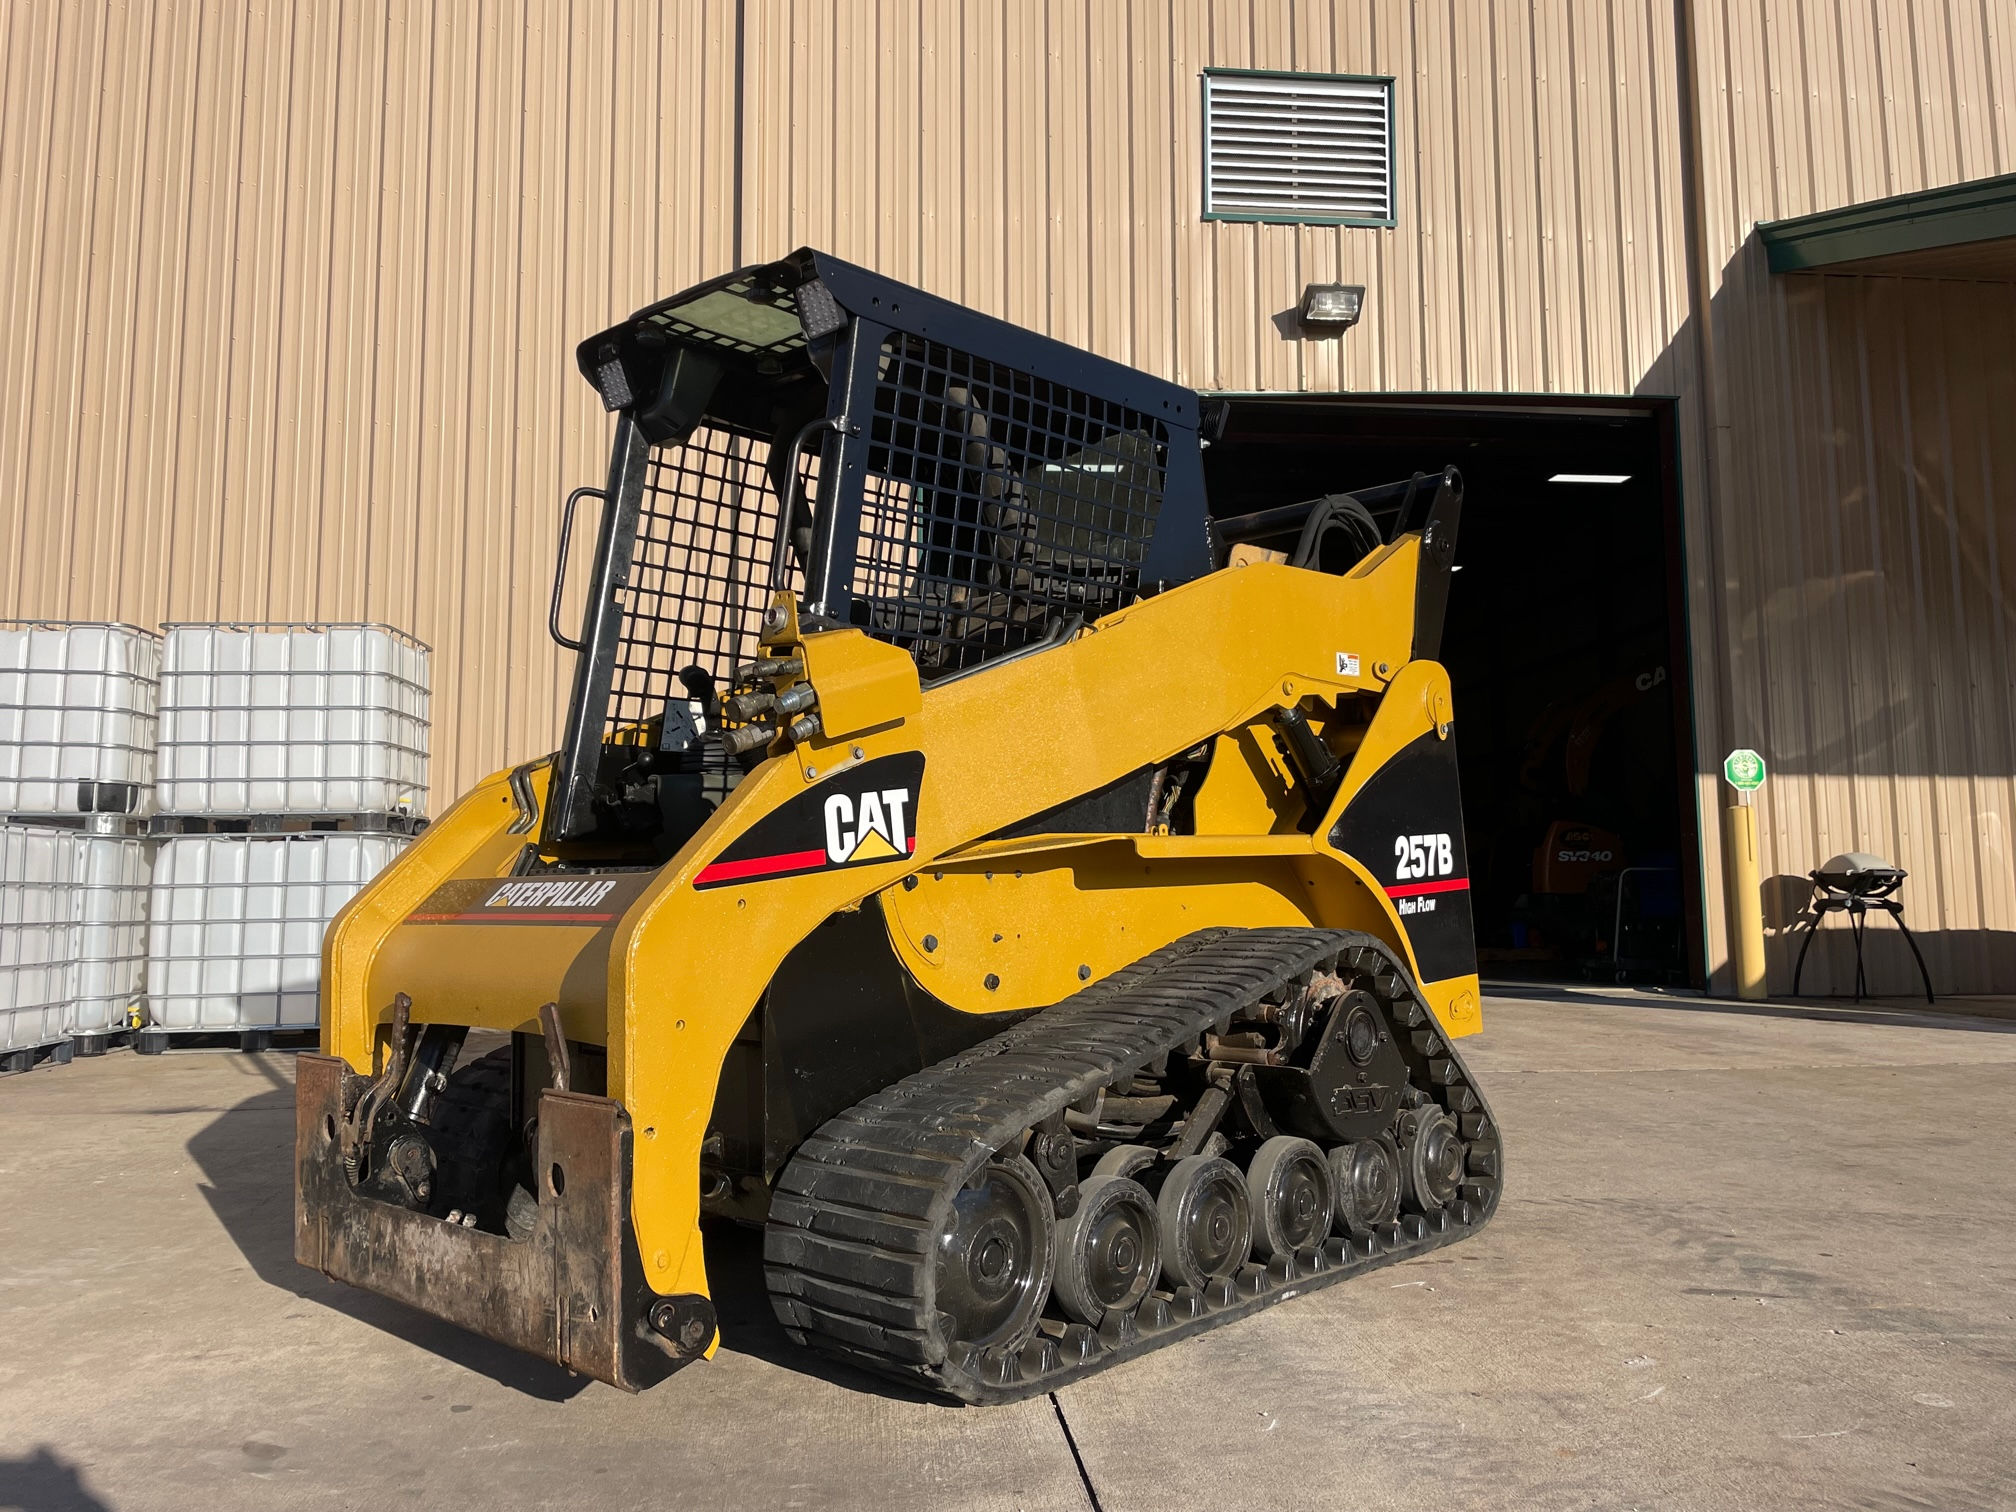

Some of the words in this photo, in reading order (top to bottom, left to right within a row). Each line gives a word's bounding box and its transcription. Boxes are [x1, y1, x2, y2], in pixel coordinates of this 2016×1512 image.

[824, 788, 909, 863] CAT
[1394, 833, 1454, 880] 257B
[484, 880, 617, 907] CATERPILLAR
